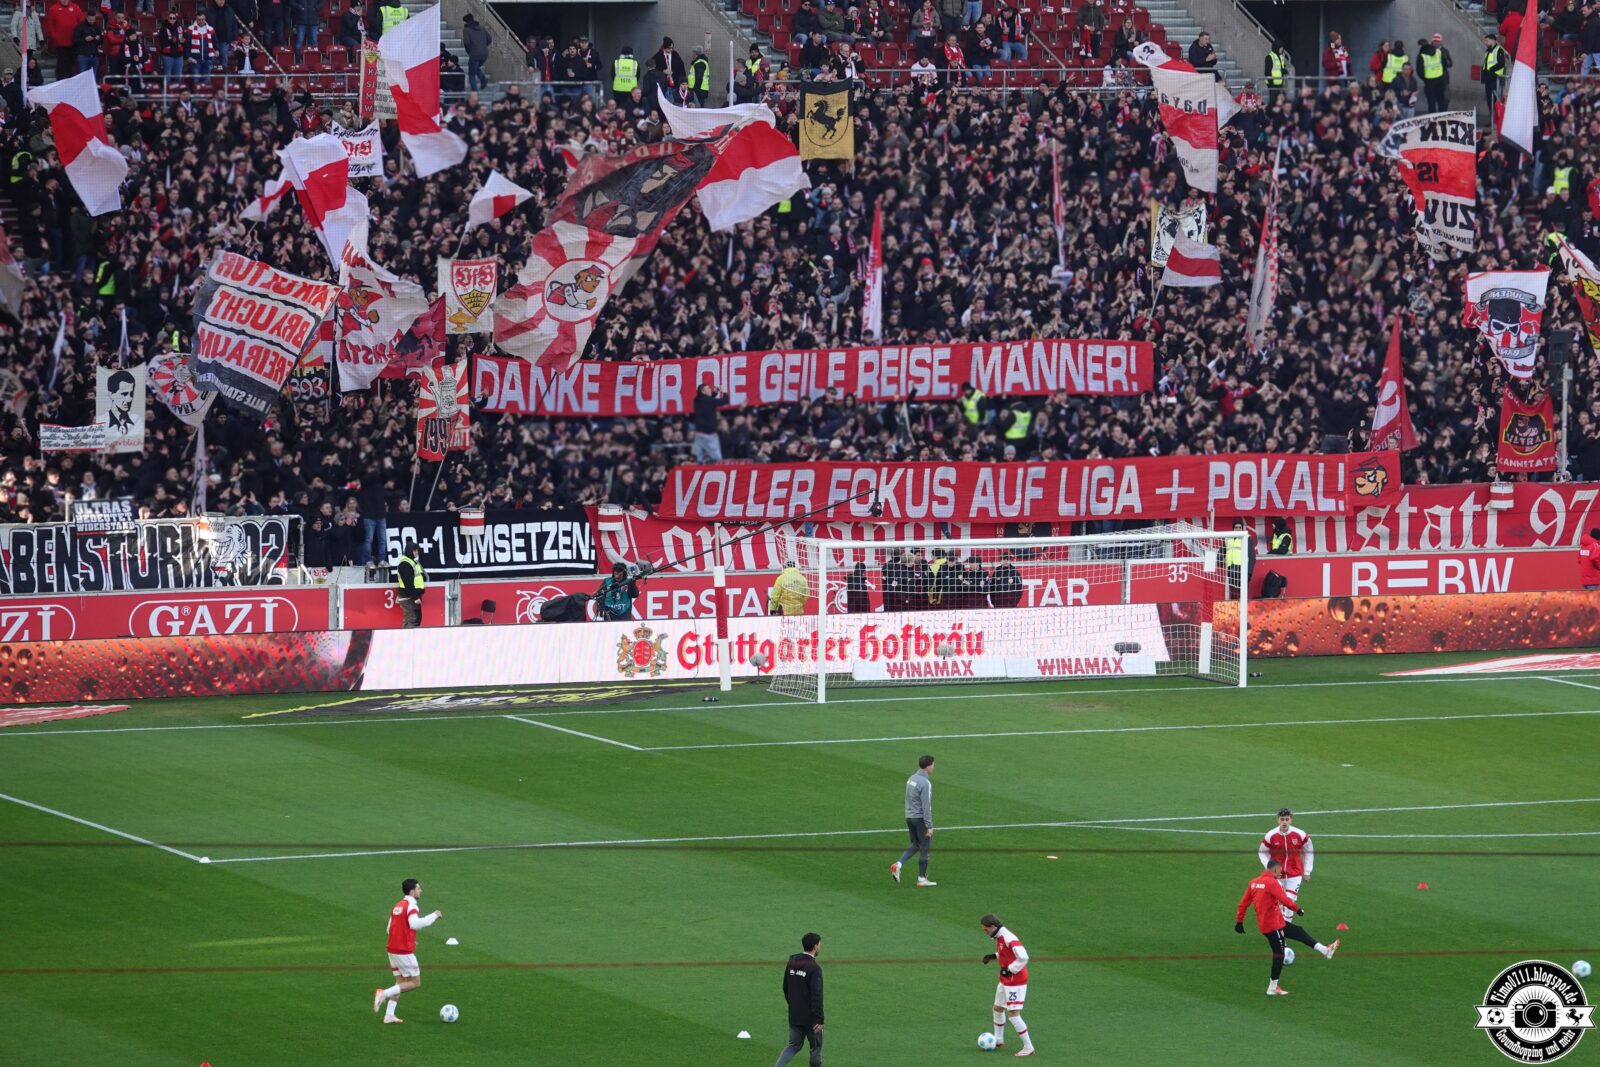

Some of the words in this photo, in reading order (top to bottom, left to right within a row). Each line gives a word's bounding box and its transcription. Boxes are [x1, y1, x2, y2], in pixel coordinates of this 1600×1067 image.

[474, 357, 601, 413] DANKE
[613, 361, 683, 413] FÜR
[696, 352, 747, 406] DIE
[758, 351, 847, 402] GEILE
[855, 346, 958, 399] REISE,
[970, 342, 1139, 393] MÄNNER!
[1498, 456, 1555, 468] CANNSTATT
[674, 466, 815, 518] VOLLER
[827, 465, 957, 519] FOKUS
[969, 466, 1048, 518] AUF
[1059, 464, 1143, 517] LIGA
[1155, 468, 1195, 512] +
[1208, 458, 1346, 512] POKAL!
[74, 500, 132, 515] ULTRAS
[1529, 483, 1600, 548] 97
[75, 512, 133, 524] BEDEUTET
[76, 521, 136, 533] WIDERSTAND
[455, 521, 596, 565] UMSETZEN!
[1168, 563, 1188, 584] 35
[384, 589, 401, 609] 3
[676, 628, 853, 675] Stuttgarter
[857, 621, 985, 661] Hofbräu
[886, 659, 975, 678] WINAMAX
[1037, 657, 1125, 676] WINAMAX
[1008, 991, 1018, 1001] 25
